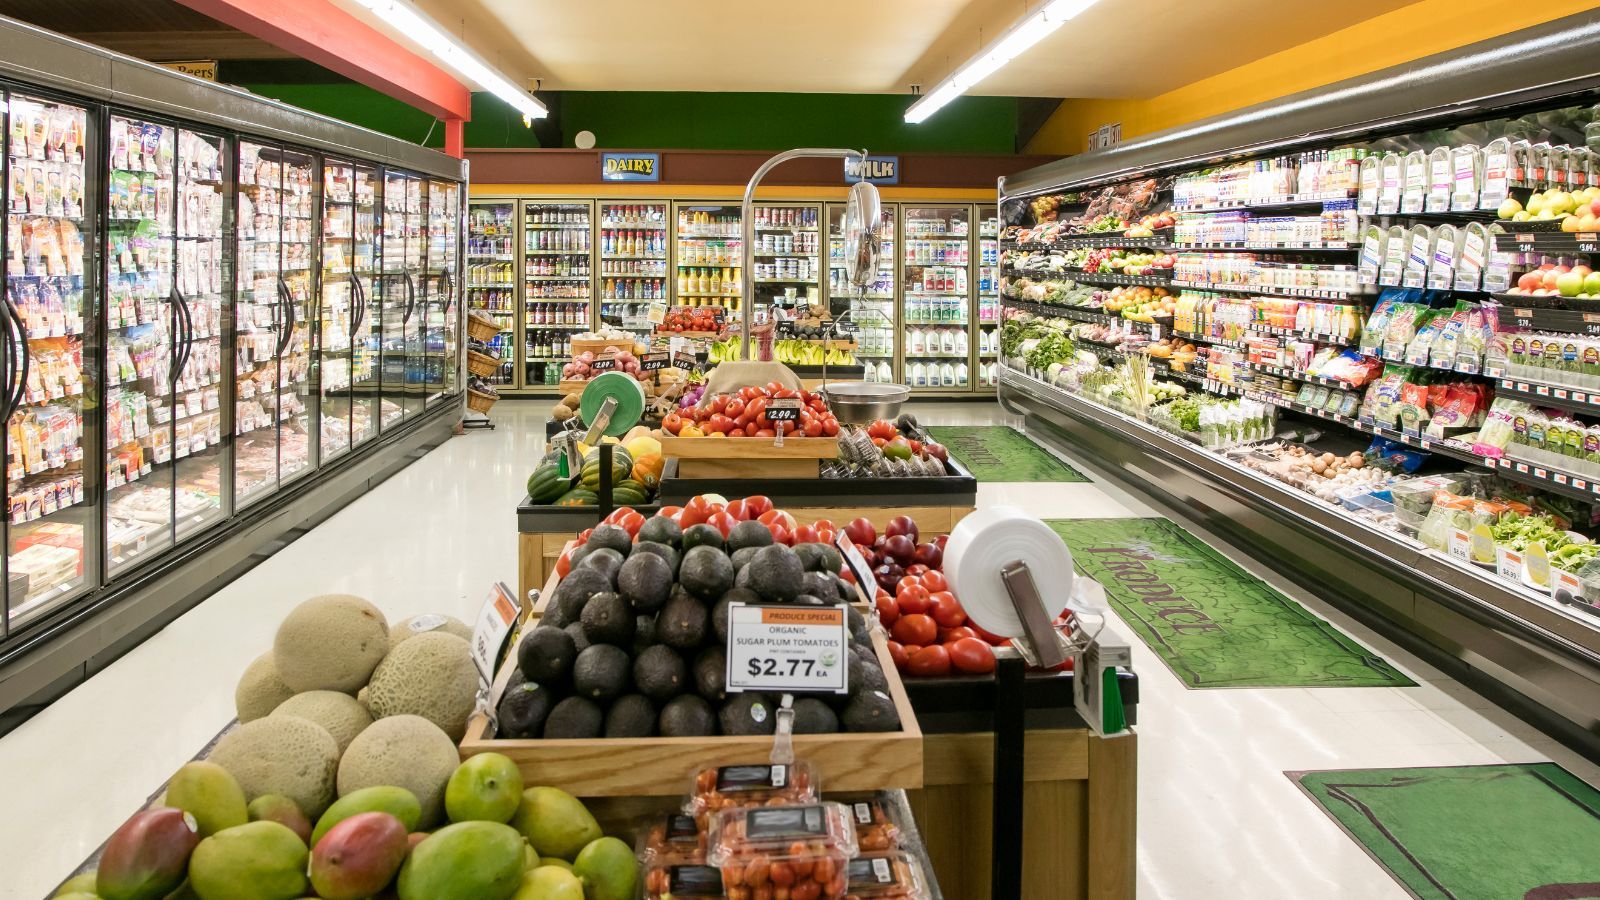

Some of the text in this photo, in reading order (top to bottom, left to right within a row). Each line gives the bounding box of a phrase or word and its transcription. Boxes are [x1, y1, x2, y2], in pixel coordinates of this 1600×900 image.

[605, 157, 654, 174] DAIRY
[848, 160, 895, 178] MILK
[769, 612, 836, 622] PRODUCE SPECIAL
[768, 626, 807, 635] ORGANIC
[736, 637, 839, 648] SUGAR PLUM TOMATOES
[747, 657, 828, 678] $2.77 EA
